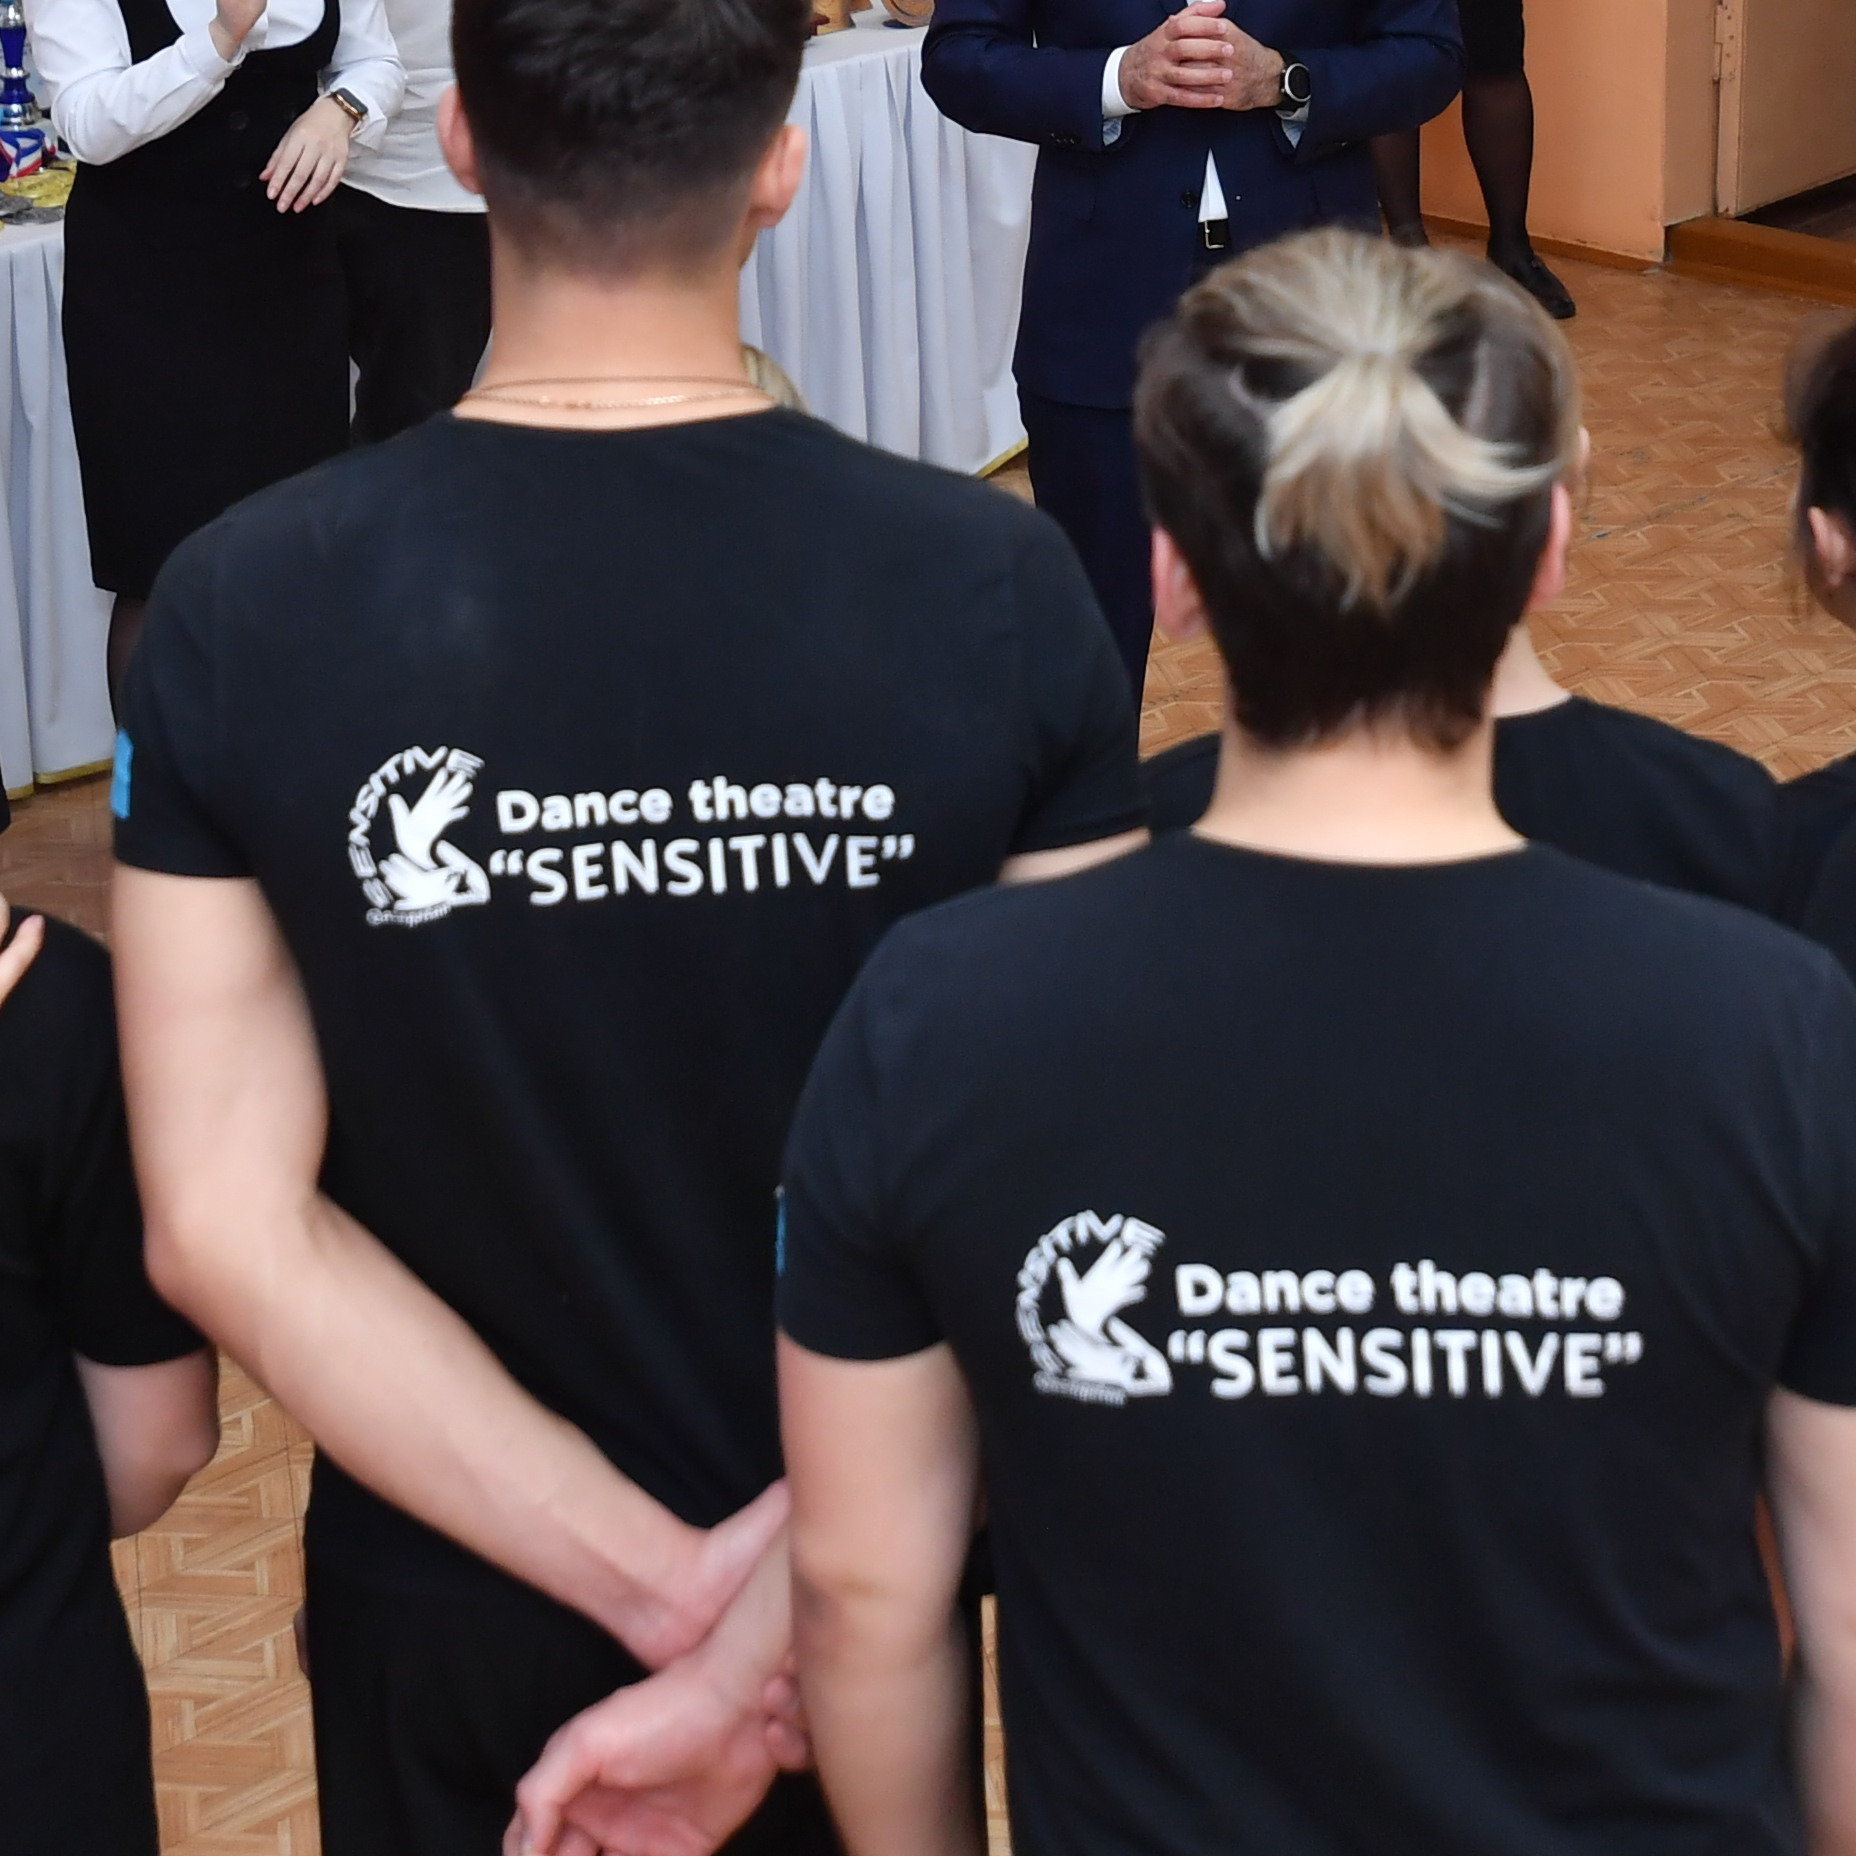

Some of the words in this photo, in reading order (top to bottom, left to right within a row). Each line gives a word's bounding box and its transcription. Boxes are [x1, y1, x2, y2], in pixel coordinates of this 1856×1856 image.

[497, 786, 673, 833] Dance
[689, 775, 896, 823] theatre
[1174, 1262, 1376, 1317] Dance
[1390, 1259, 1626, 1321] theatre
